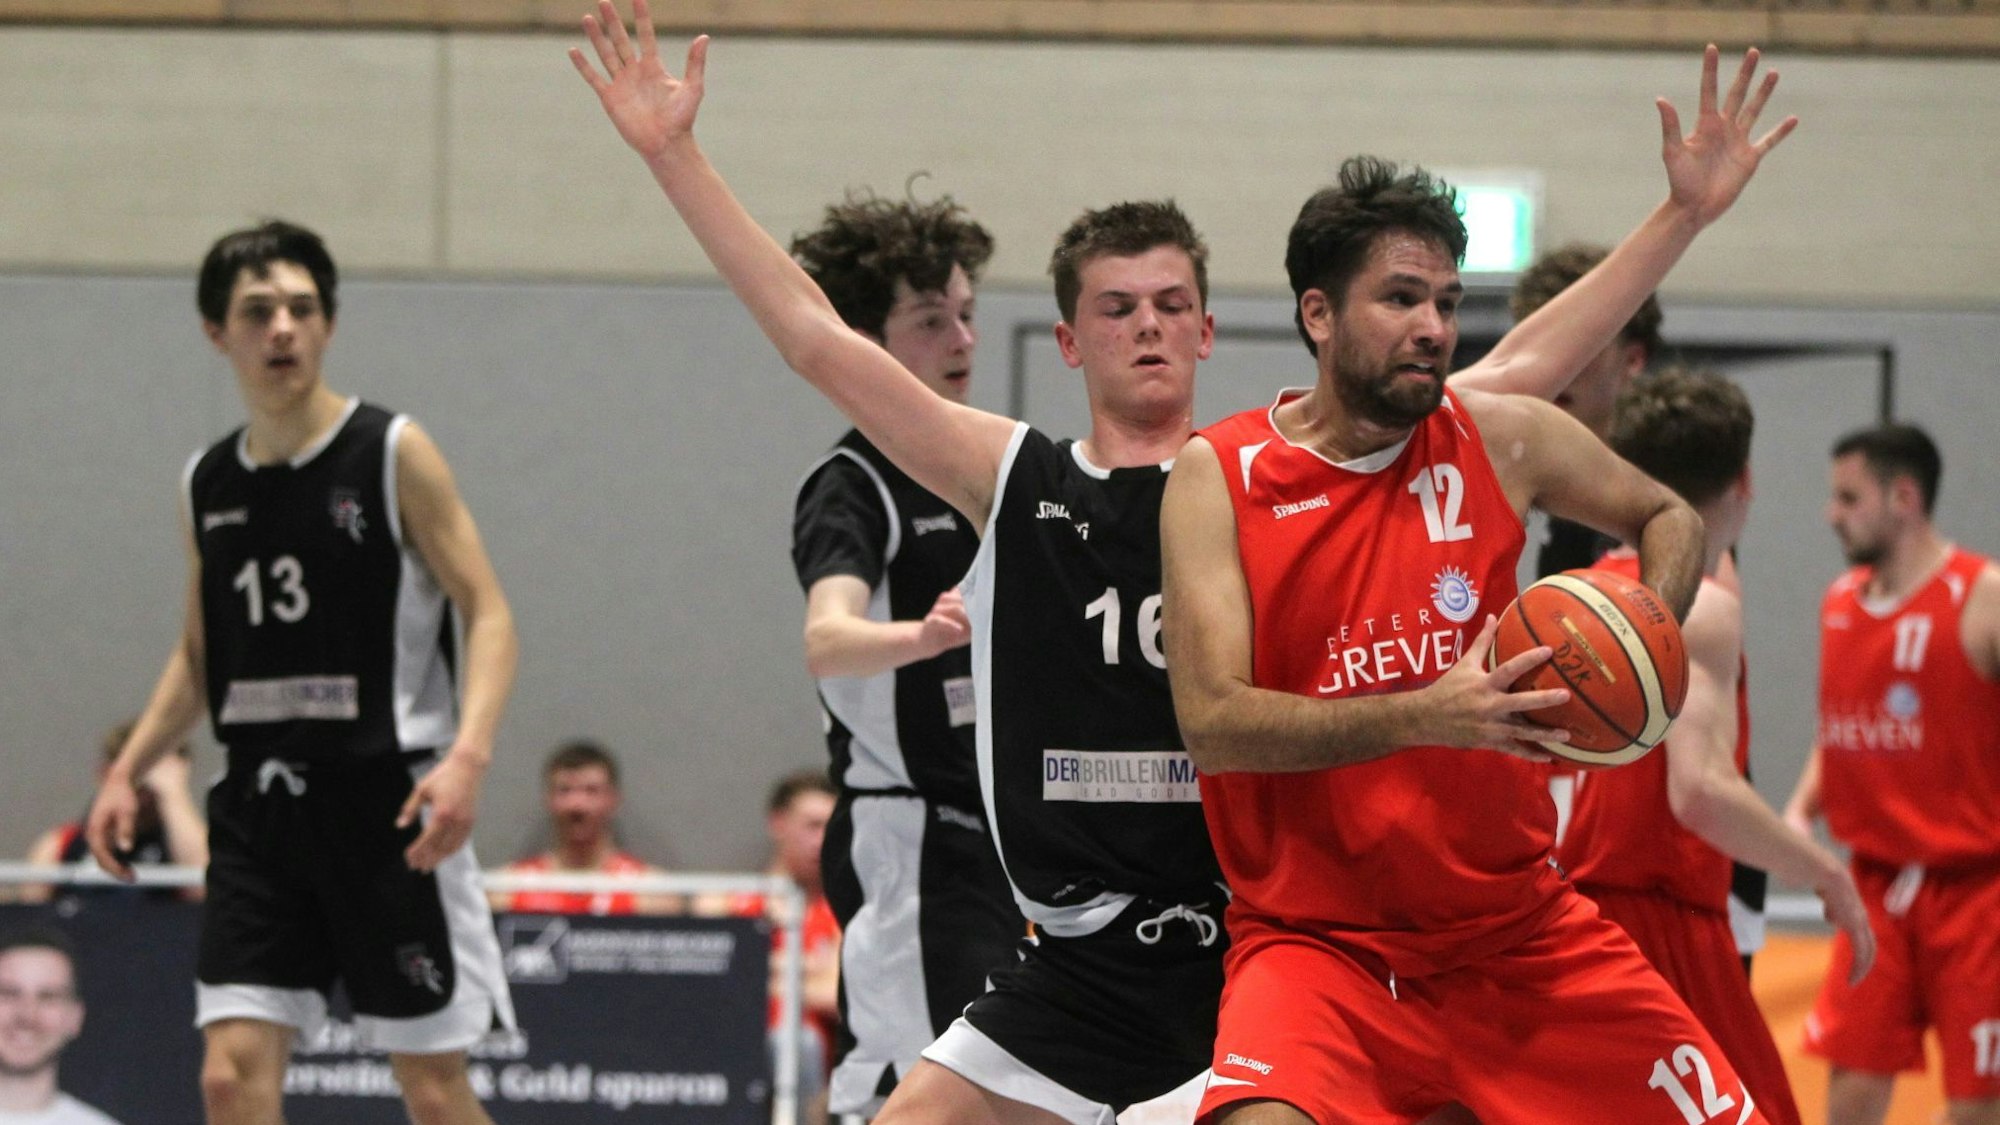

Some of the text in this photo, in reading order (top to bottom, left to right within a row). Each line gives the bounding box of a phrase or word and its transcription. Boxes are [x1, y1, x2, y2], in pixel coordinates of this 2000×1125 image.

[1036, 501, 1089, 541] SPALG
[1273, 494, 1330, 520] SPALDING
[1408, 463, 1473, 543] 12
[233, 555, 310, 626] 13
[1327, 609, 1431, 653] PETER
[1137, 787, 1191, 799] GODE
[1223, 1053, 1274, 1076] SPALDING
[1648, 1044, 1736, 1125] 12
